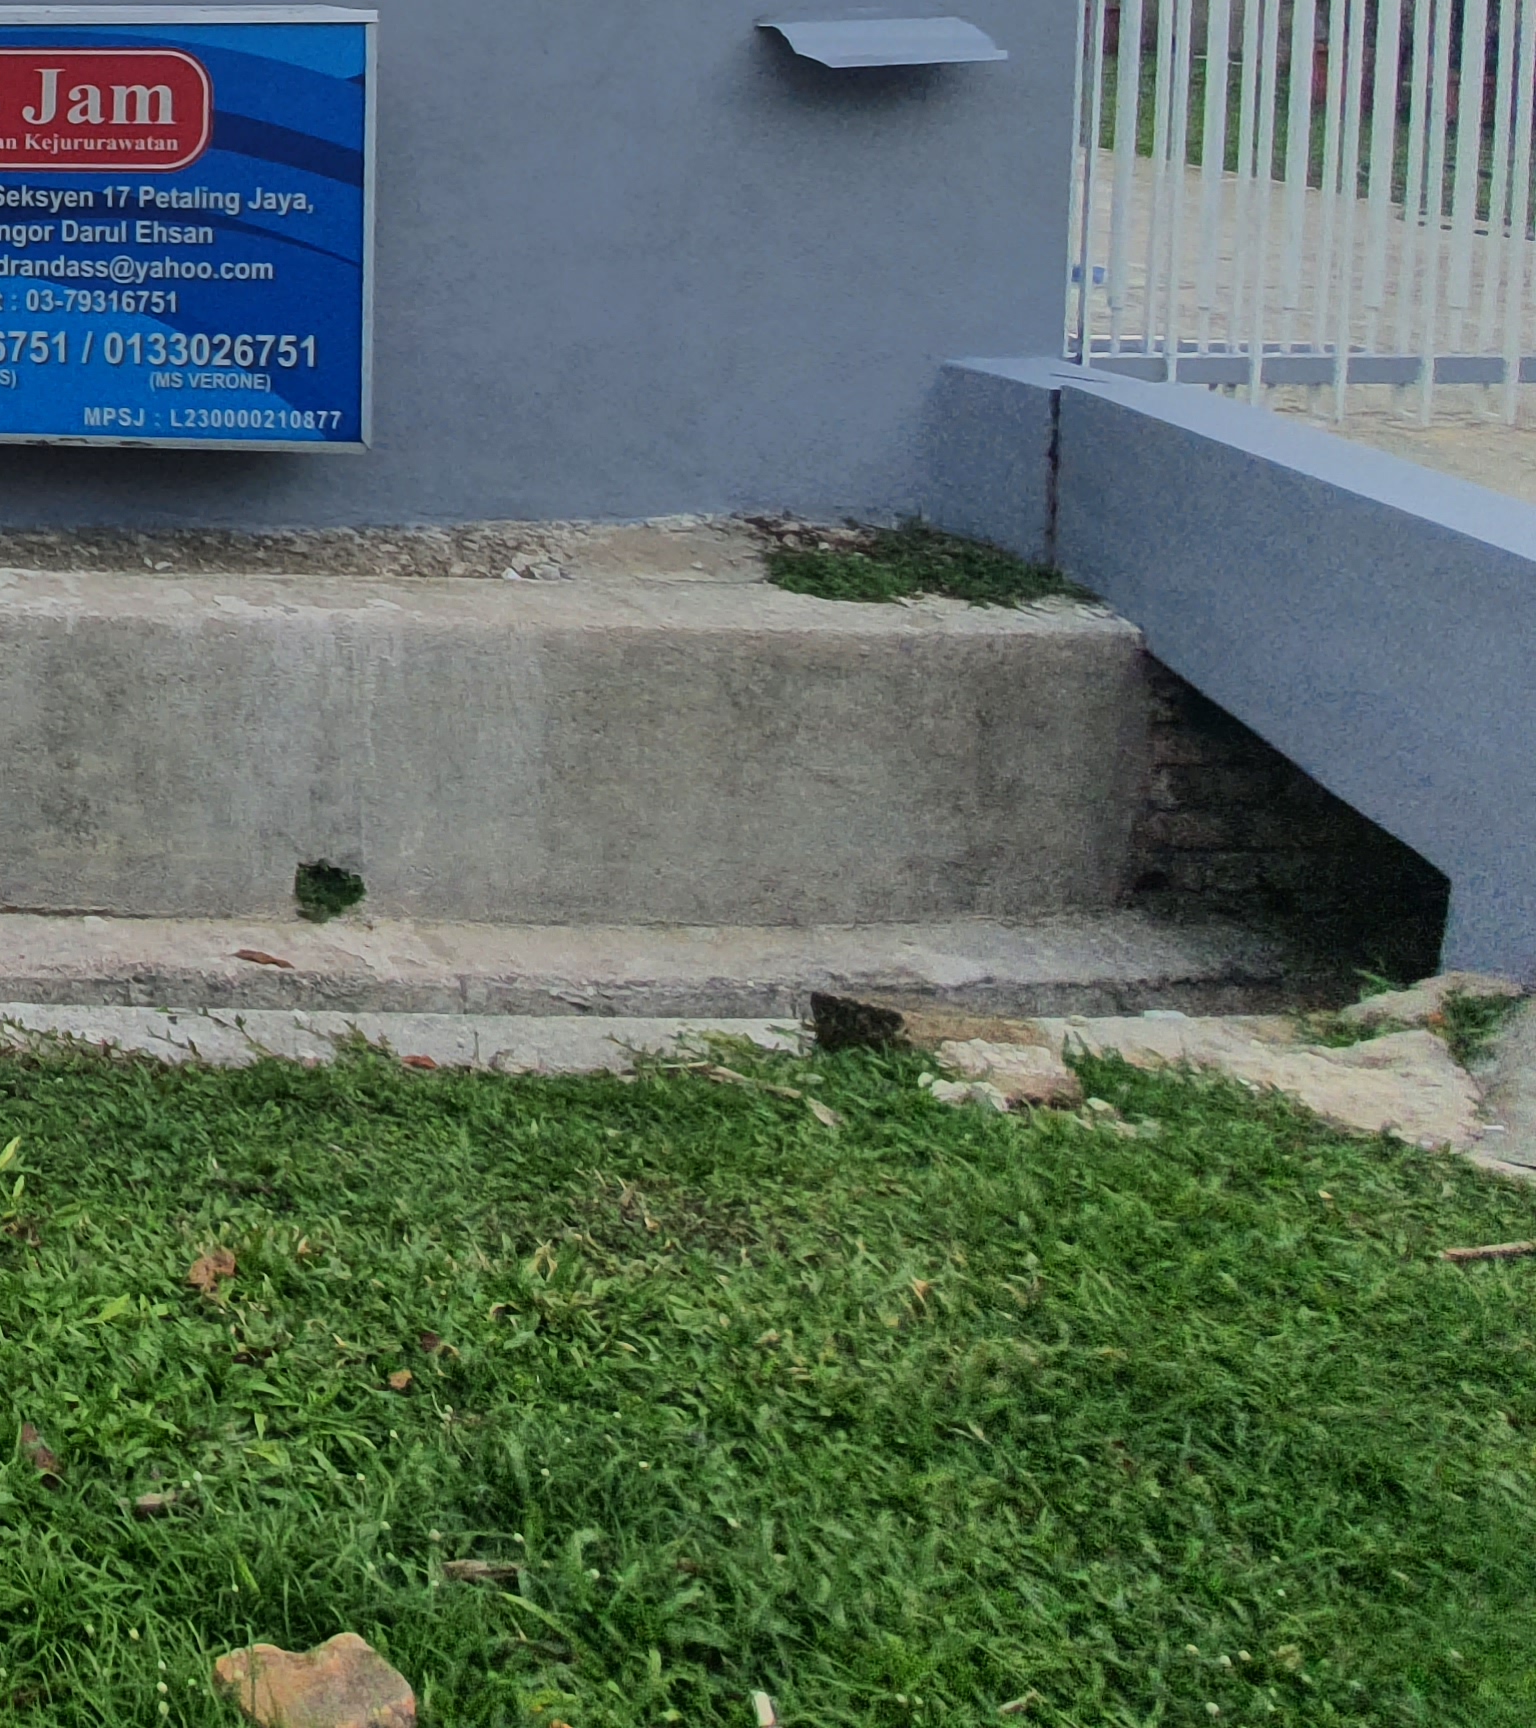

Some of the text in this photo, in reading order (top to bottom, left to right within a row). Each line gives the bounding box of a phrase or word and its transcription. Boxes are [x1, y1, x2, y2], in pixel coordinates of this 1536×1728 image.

[21, 68, 177, 125] Jam
[25, 133, 178, 154] Kejururawatan
[102, 186, 131, 208] 17
[138, 186, 240, 215] Petaling
[247, 187, 314, 215] Jaya,
[61, 220, 127, 243] Darul
[135, 221, 214, 244] Ehsan
[26, 289, 177, 313] 03-79316751
[104, 332, 317, 368] 0133026751
[149, 372, 271, 393] (MS VERONE)
[84, 407, 145, 427] MPSJ
[170, 409, 342, 430] L230000210877
